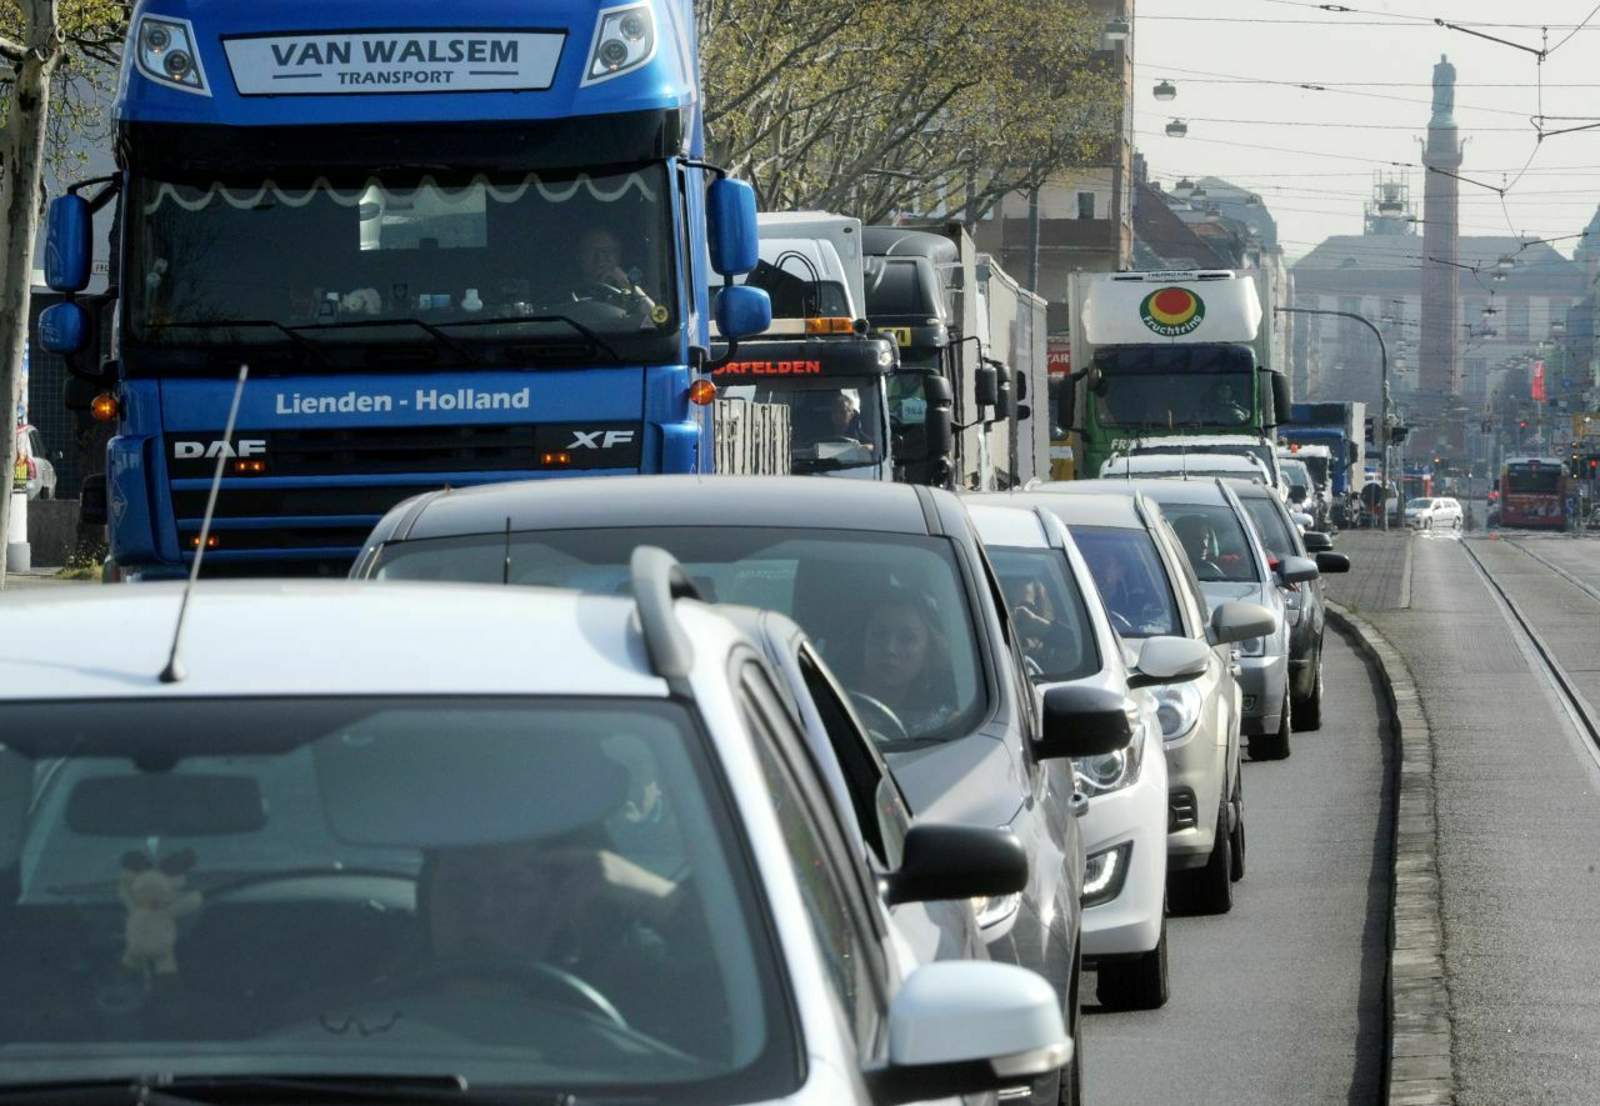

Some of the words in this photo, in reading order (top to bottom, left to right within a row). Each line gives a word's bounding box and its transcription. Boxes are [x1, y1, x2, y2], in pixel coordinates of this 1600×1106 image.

[271, 41, 351, 66] VAN
[362, 39, 518, 63] WALSEM
[338, 70, 454, 84] TRANSPORT
[1143, 315, 1202, 335] Fruchtring
[276, 391, 392, 414] Lienden
[416, 387, 530, 411] Holland
[565, 430, 635, 449] XF
[174, 440, 266, 459] DAF
